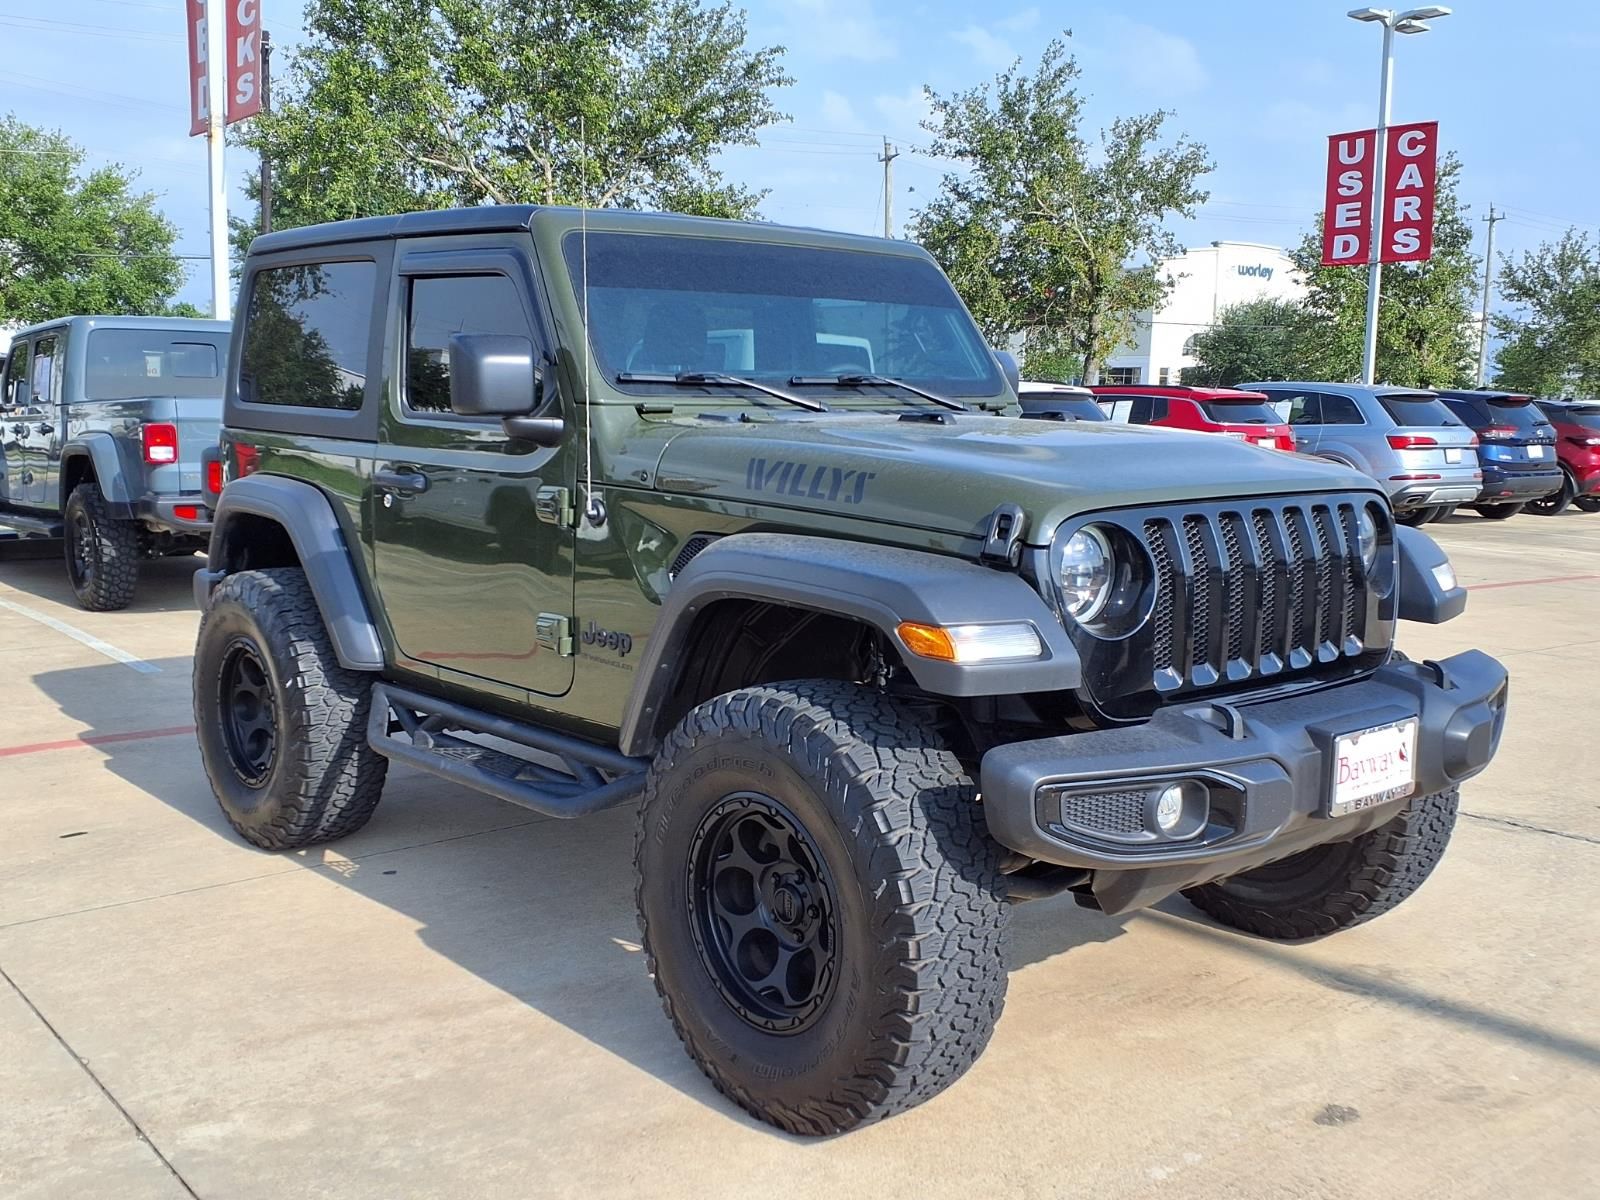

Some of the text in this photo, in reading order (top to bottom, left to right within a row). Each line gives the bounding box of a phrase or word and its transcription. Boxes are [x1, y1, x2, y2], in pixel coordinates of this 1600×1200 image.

[1332, 130, 1426, 259] USED CARS
[1238, 264, 1274, 281] worley
[746, 458, 877, 504] WILLYS
[582, 620, 632, 657] Jeep
